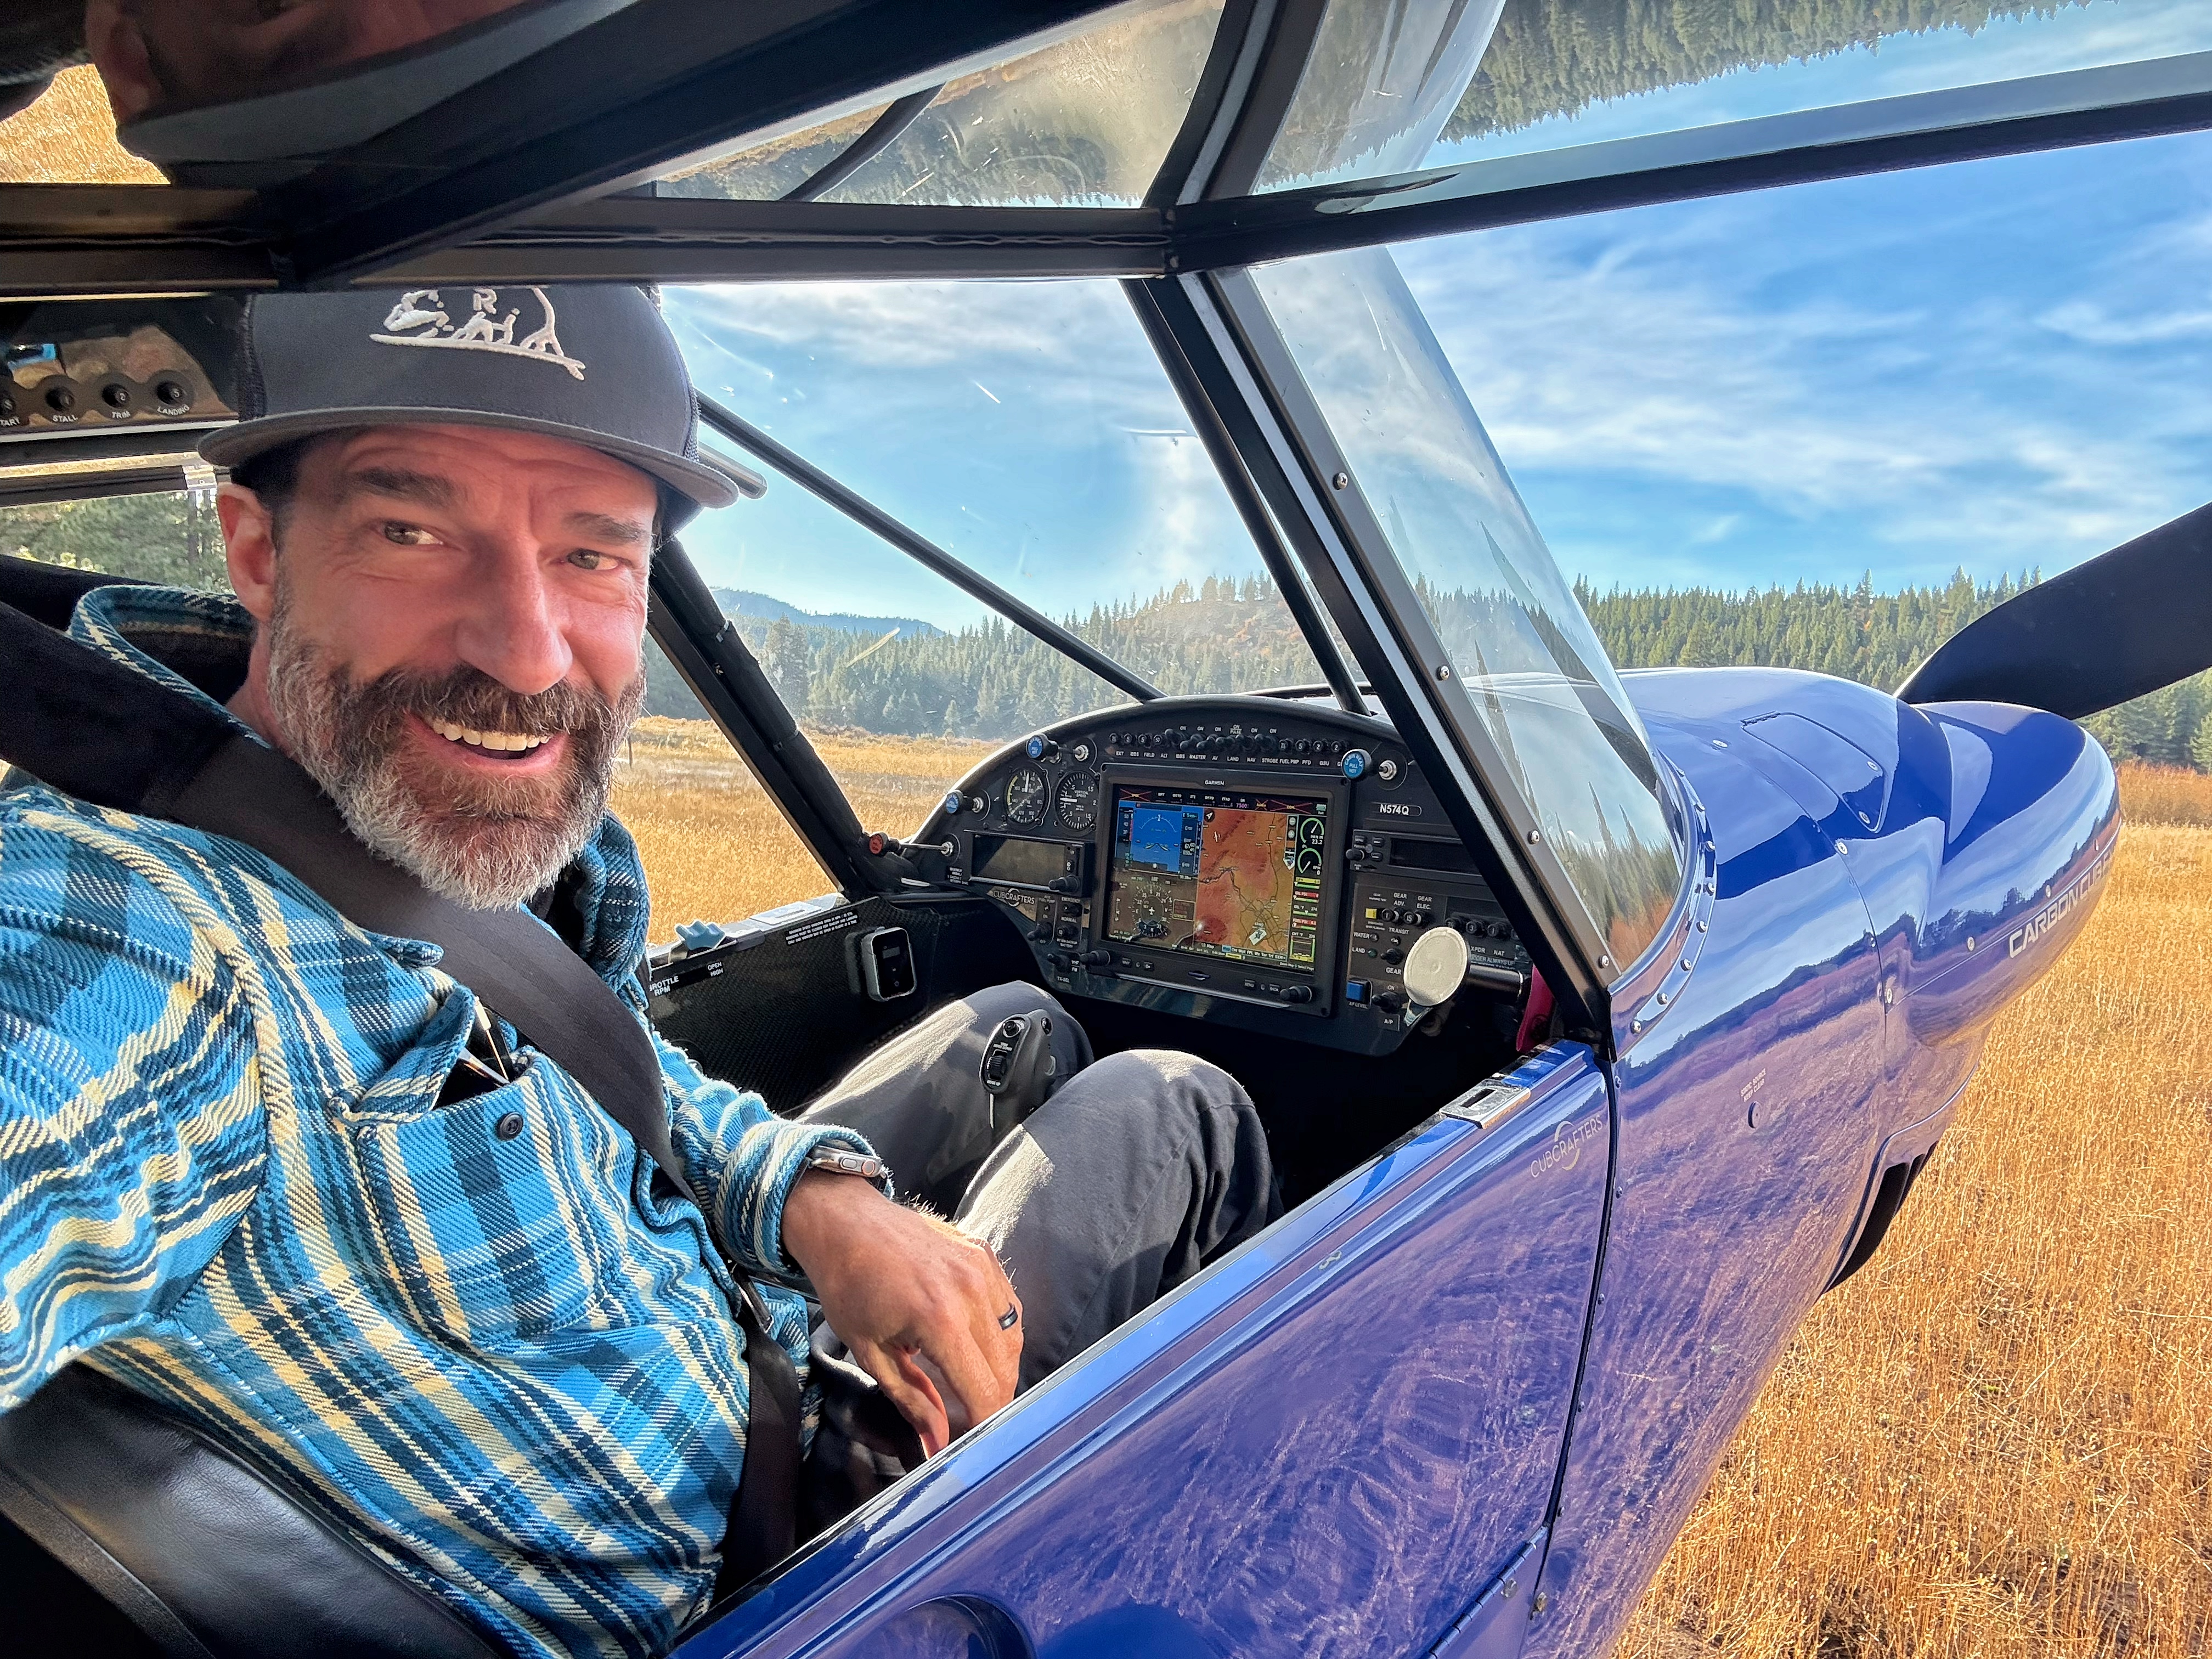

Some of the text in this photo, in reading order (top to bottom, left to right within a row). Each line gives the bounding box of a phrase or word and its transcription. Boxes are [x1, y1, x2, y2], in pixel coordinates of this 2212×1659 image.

[111, 410, 131, 419] TRIM
[157, 404, 190, 416] LANDING
[0, 416, 20, 427] TART
[52, 414, 78, 422] STALL
[1380, 804, 1409, 816] N574Q
[993, 890, 1035, 904] CUBCRAFTERS
[2010, 885, 2079, 958] CARBON
[2080, 860, 2102, 901] CUB
[707, 961, 722, 970] OPEN
[710, 968, 724, 977] HIGH
[654, 985, 670, 996] RPM
[1531, 1114, 1602, 1177] CUBCRAFTERS
